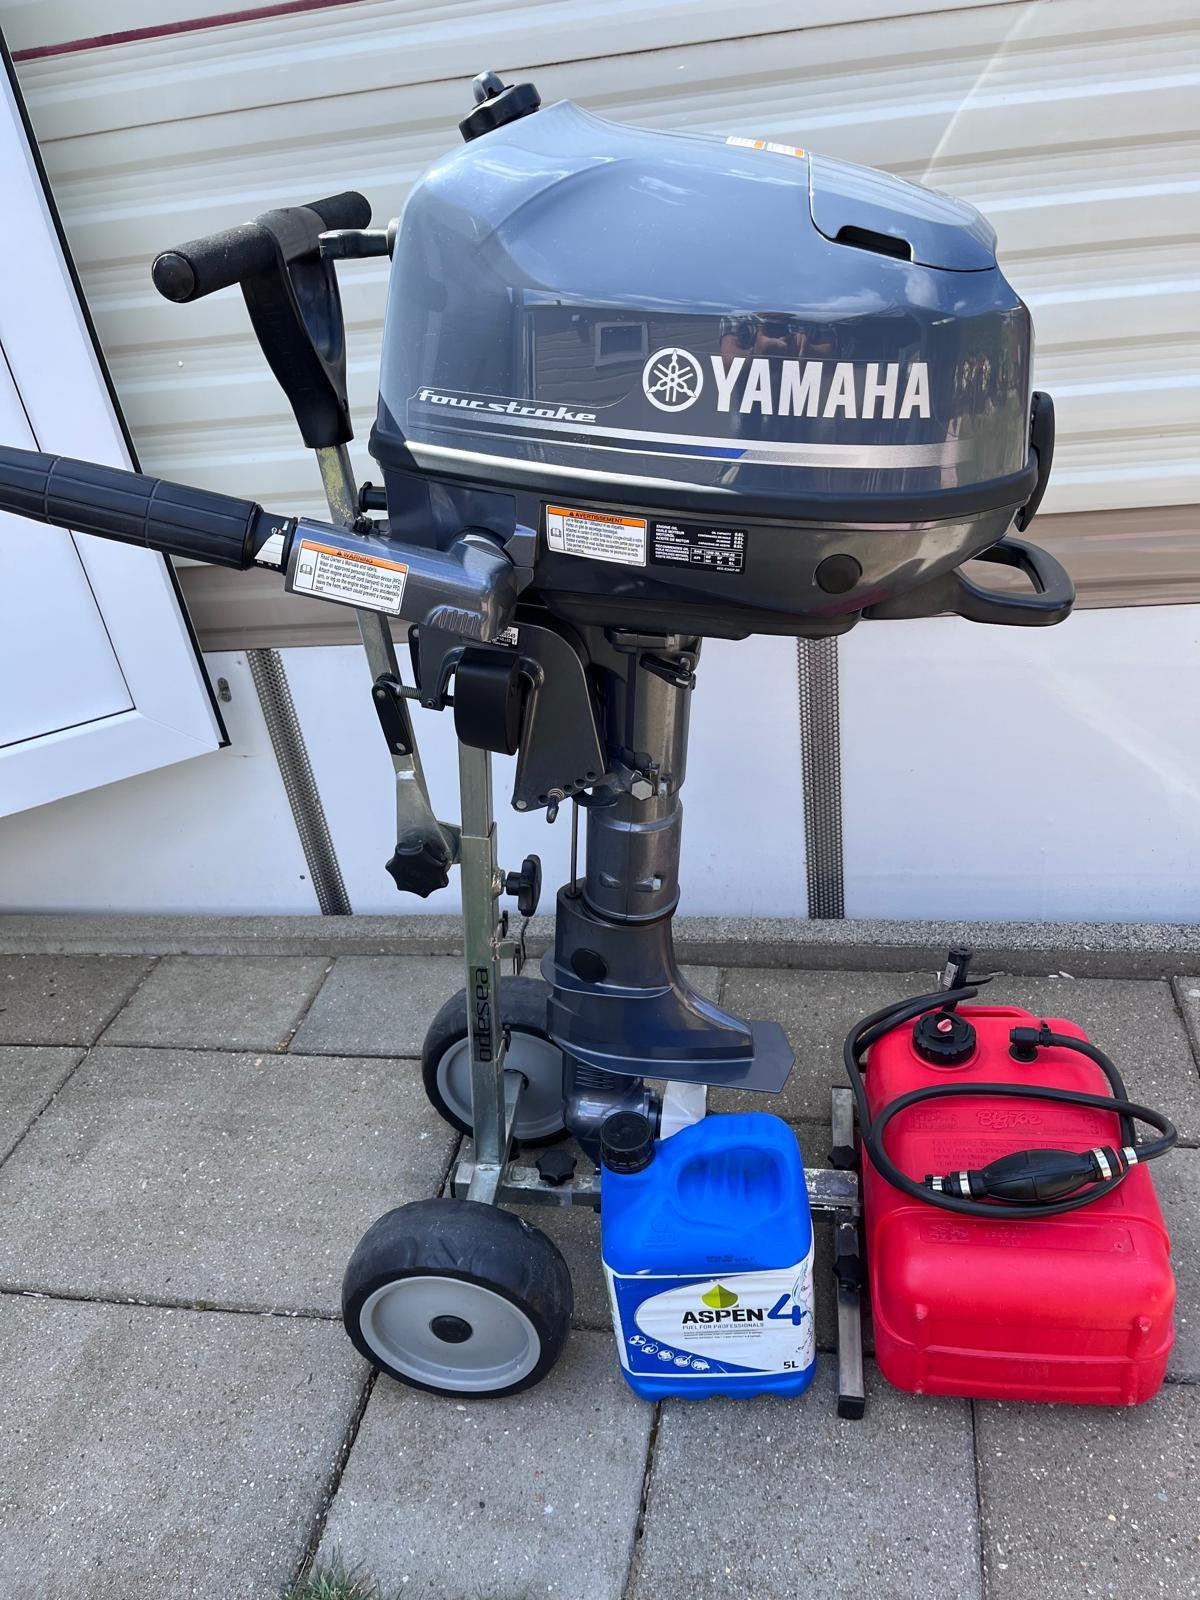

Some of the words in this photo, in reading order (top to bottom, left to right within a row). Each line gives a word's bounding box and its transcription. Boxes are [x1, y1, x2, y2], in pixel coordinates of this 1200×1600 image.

[711, 356, 930, 419] YAMAHA
[576, 512, 623, 524] AVERTISSEMENT
[343, 551, 373, 565] WARNING
[475, 968, 492, 1062] odesea
[682, 1308, 764, 1324] ASPEN
[767, 1293, 807, 1326] 4
[783, 1361, 799, 1370] 5L
